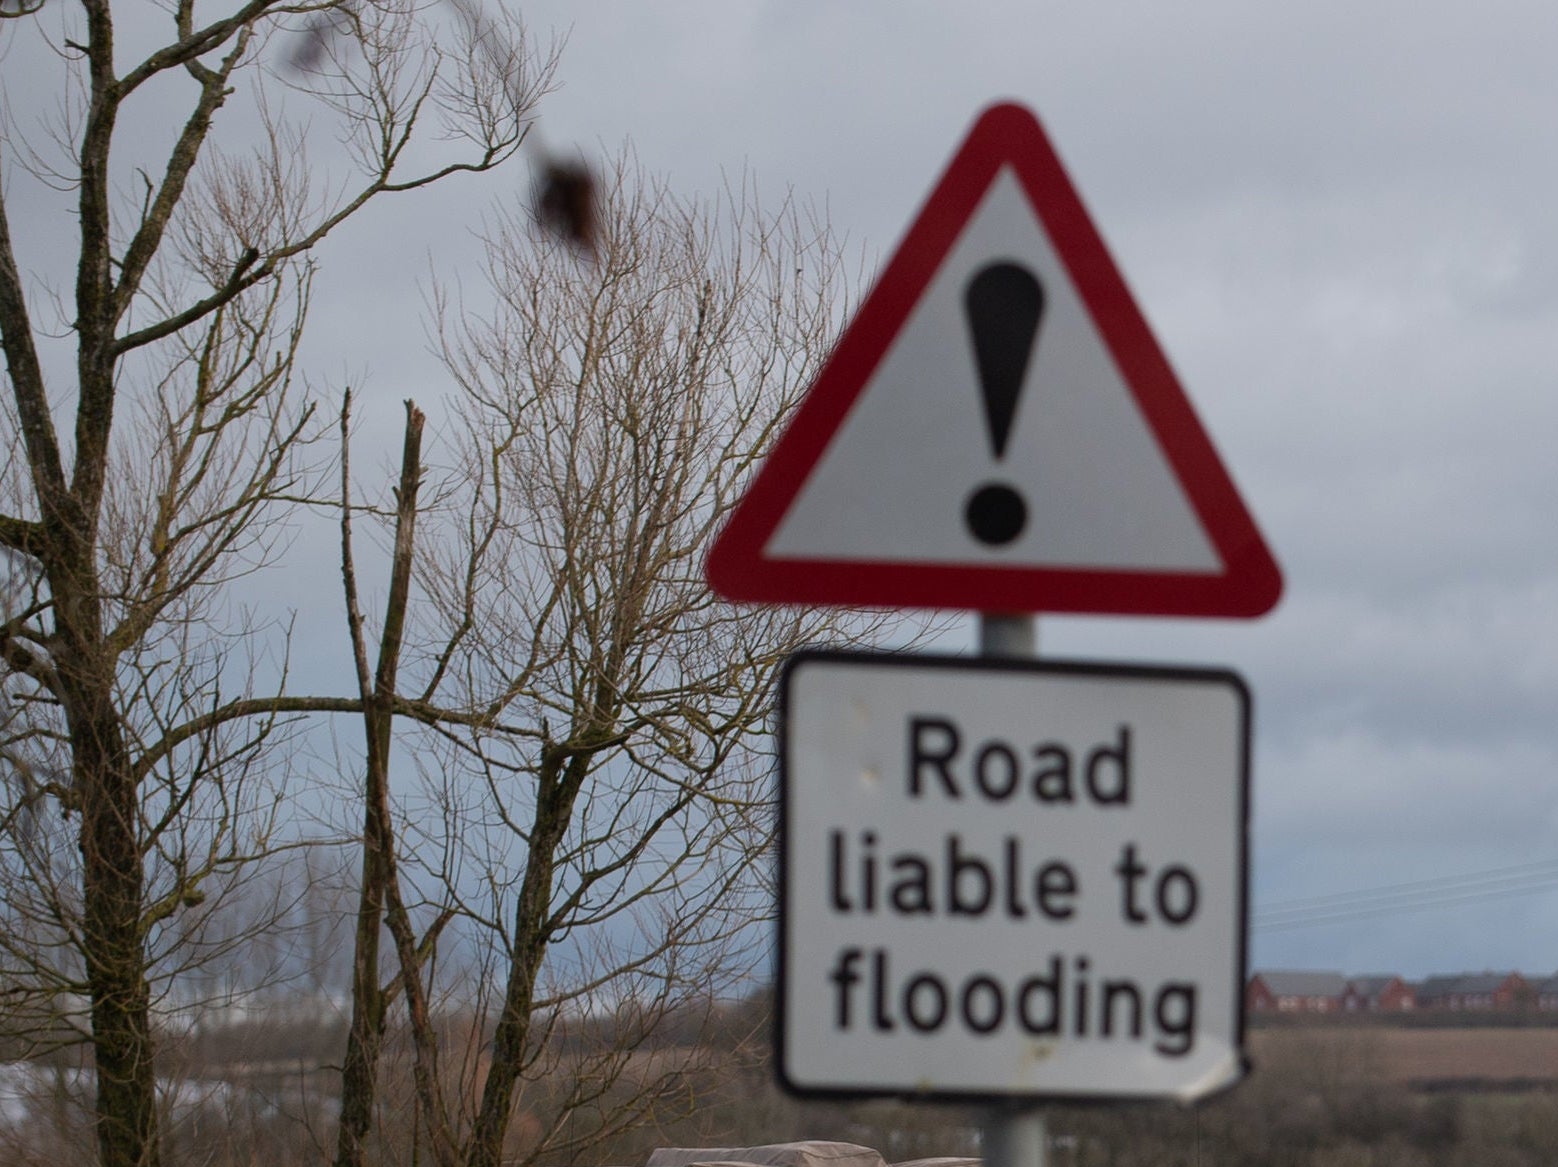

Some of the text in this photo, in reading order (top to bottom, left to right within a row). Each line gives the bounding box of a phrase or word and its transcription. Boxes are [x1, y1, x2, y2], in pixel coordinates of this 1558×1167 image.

[907, 714, 1133, 806] Road
[828, 830, 1201, 926] liable to
[829, 947, 1198, 1058] flooding
